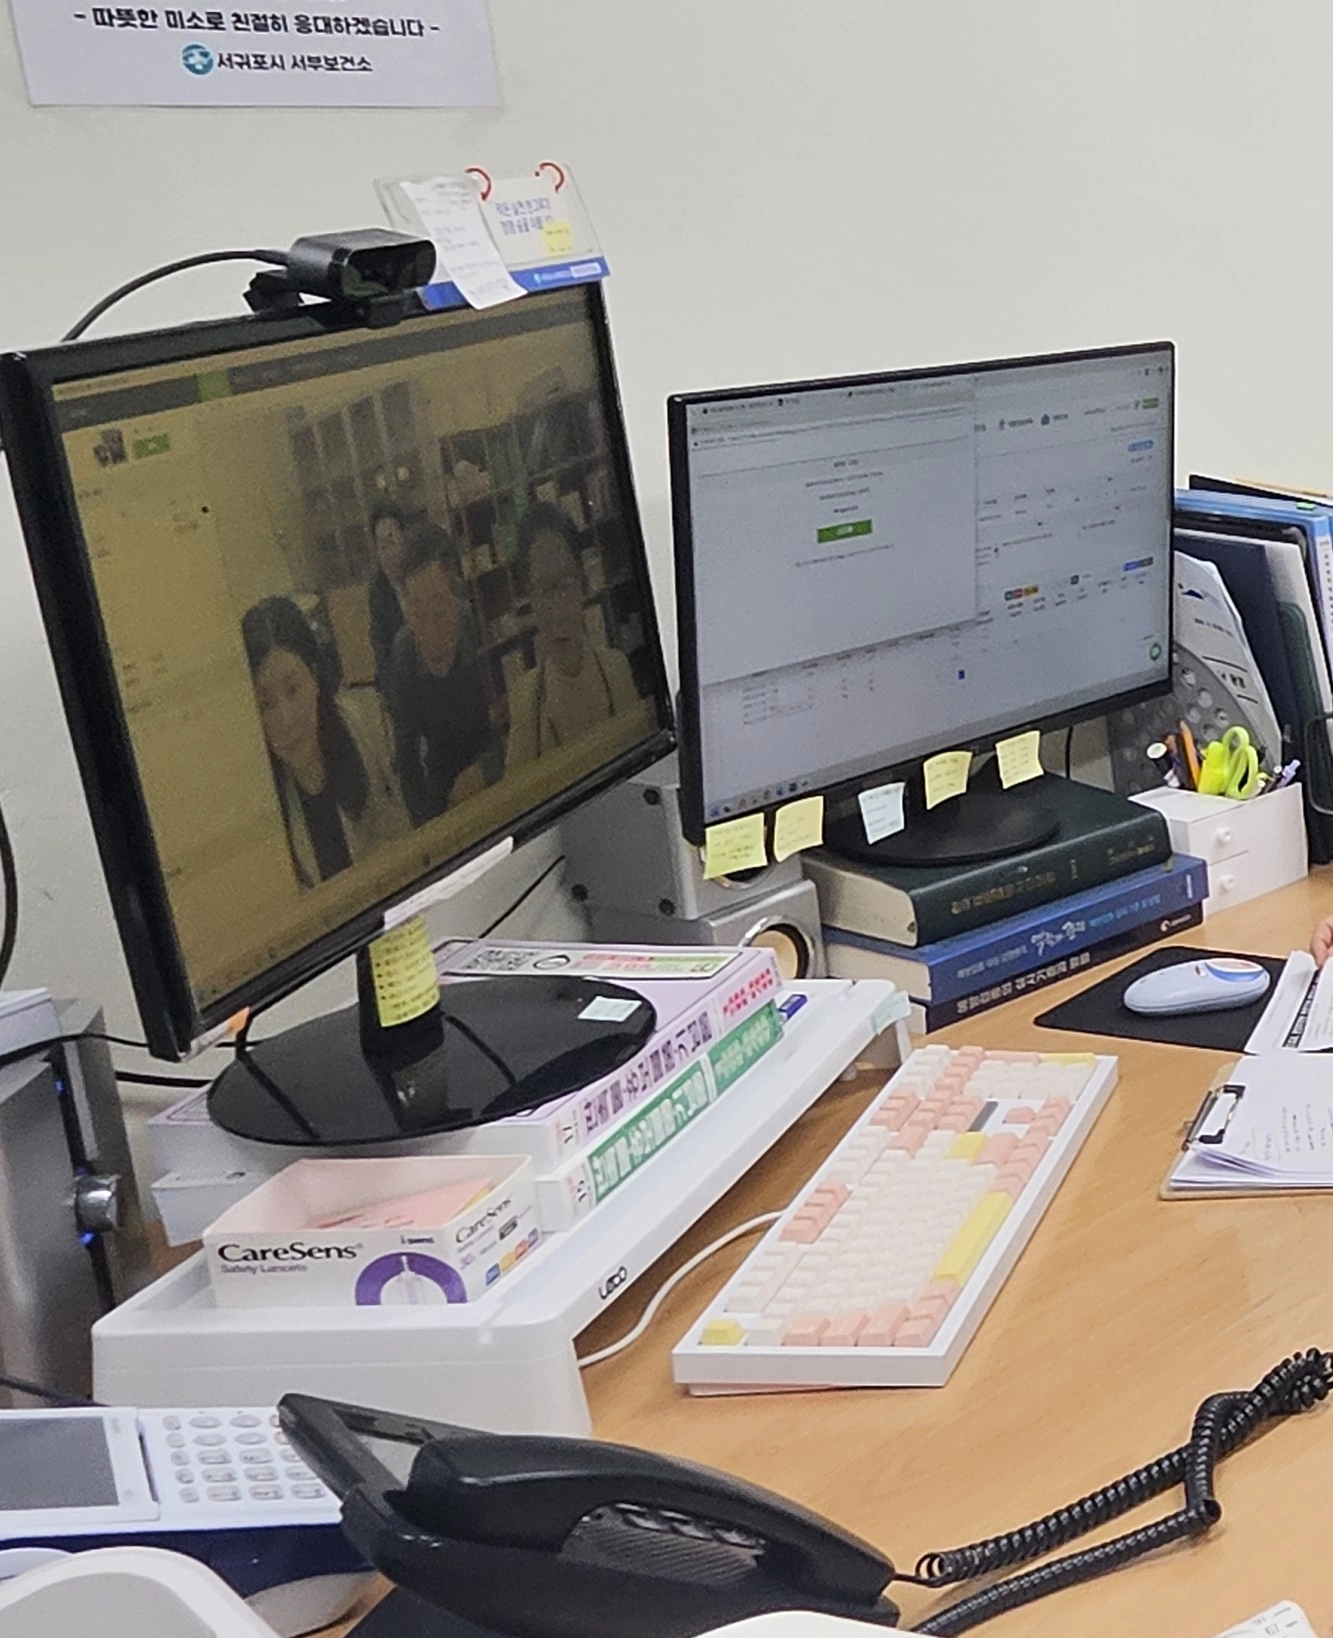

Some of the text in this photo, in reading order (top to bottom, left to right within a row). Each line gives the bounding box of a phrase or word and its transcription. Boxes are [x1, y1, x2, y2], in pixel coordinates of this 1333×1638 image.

[92, 7, 158, 29] 따뜻한
[165, 9, 226, 31] 미소로
[231, 11, 289, 34] 친절히
[294, 14, 425, 37] 응대하겠습니다
[217, 53, 373, 73] 서귀포시 서부보건소
[217, 1242, 357, 1264] CareSens
